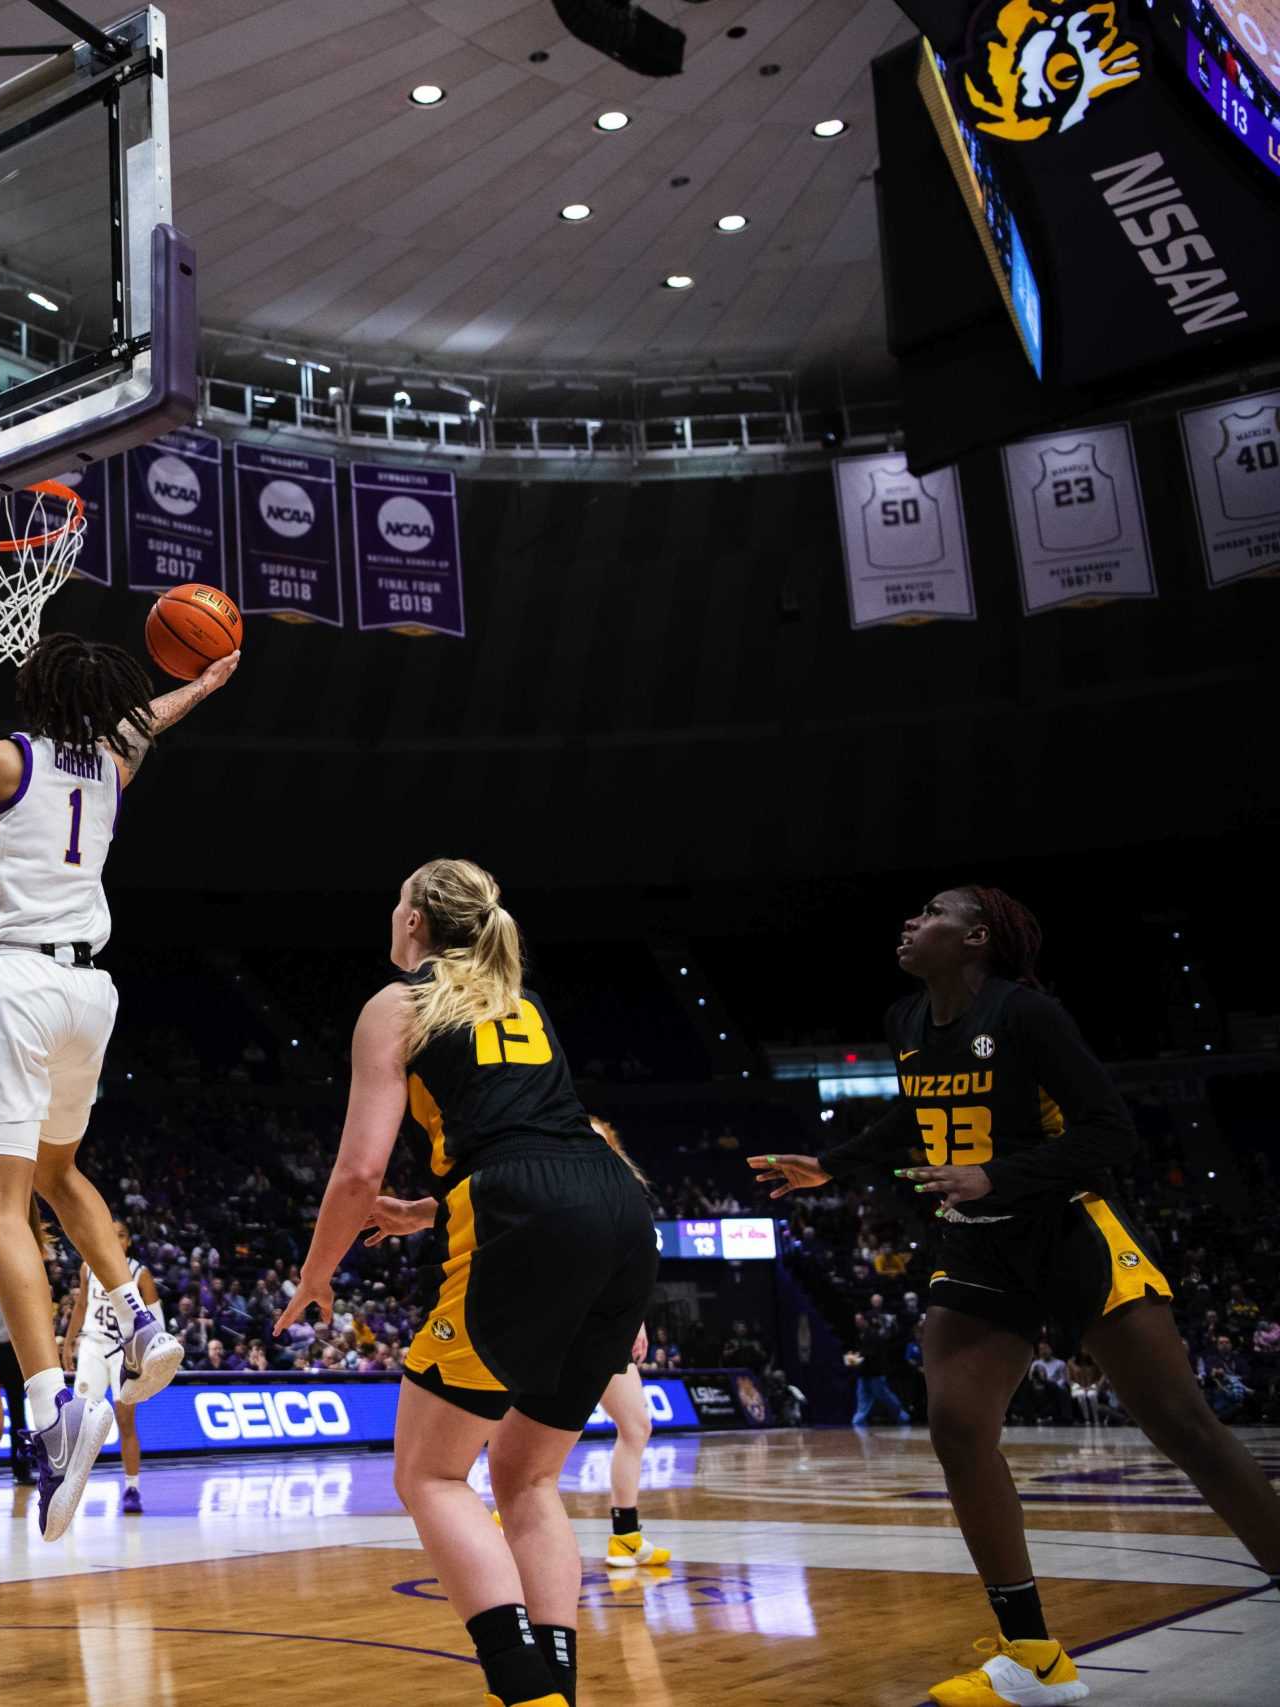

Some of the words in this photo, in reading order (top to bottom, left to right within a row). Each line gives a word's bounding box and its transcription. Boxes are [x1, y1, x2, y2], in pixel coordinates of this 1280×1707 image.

[1231, 98, 1248, 135] 13
[1091, 151, 1248, 335] NISSAN
[1236, 440, 1279, 473] 40
[153, 481, 200, 504] NCAA
[1052, 476, 1095, 508] 23
[266, 503, 315, 526] NCAA
[881, 498, 920, 526] 50
[384, 521, 433, 539] NCAA
[147, 538, 184, 557] SUPER
[186, 545, 203, 561] SIX
[155, 555, 196, 580] 2017
[260, 562, 298, 580] SUPER
[300, 568, 319, 582] SIX
[268, 578, 313, 601] 2018
[378, 577, 409, 591] FINAL
[412, 580, 442, 594] FOUR
[194, 587, 238, 626] ELITE
[388, 592, 433, 613] 2019
[63, 787, 82, 867] 1
[475, 998, 553, 1066] 13
[973, 1040, 995, 1053] SEC
[915, 1105, 994, 1167] 33
[686, 1221, 716, 1236] LSU
[94, 1304, 119, 1331] 45
[195, 1391, 351, 1440] GEICO
